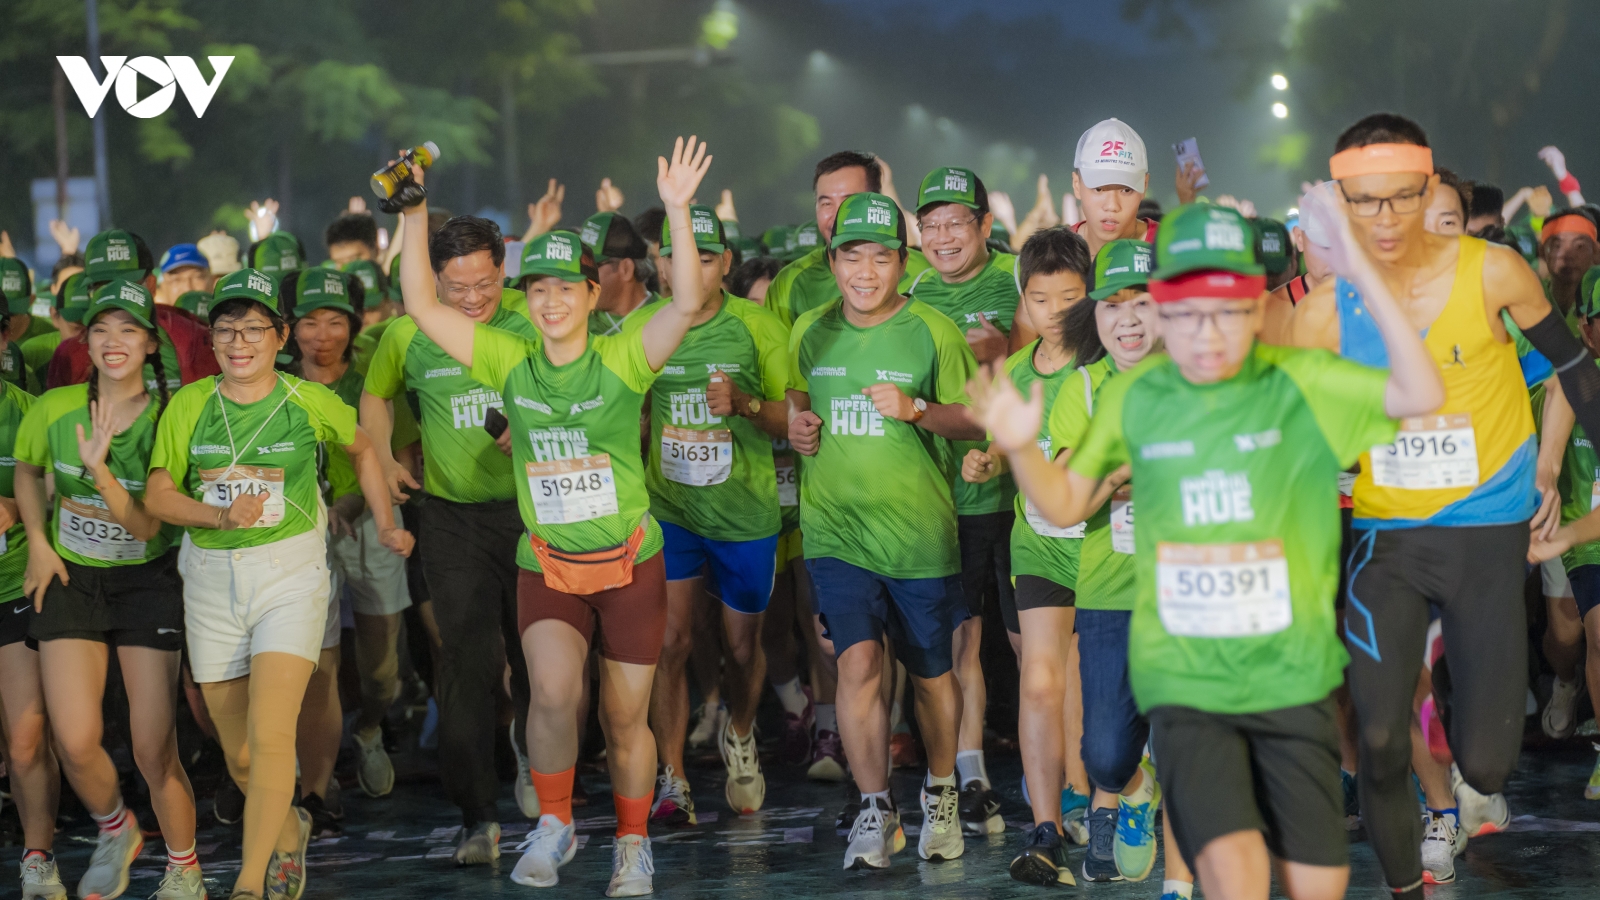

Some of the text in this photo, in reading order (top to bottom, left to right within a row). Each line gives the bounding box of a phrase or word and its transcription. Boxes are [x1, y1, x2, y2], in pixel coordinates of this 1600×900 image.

[945, 180, 967, 192] HUE
[868, 212, 891, 226] HUE
[693, 223, 714, 234] HUE
[107, 250, 130, 262] HUE
[546, 246, 573, 262] HUE
[247, 280, 272, 297] HUE
[450, 391, 502, 407] IMPERIAL
[670, 393, 707, 404] IMPERI
[831, 400, 878, 412] IMPERI
[831, 411, 885, 436] HUE
[529, 430, 588, 442] IMPERIAL
[531, 441, 592, 463] HUE
[671, 442, 718, 461] 51631
[541, 473, 602, 497] 51948
[1183, 491, 1254, 526] HUE
[1178, 567, 1269, 597] 50391
